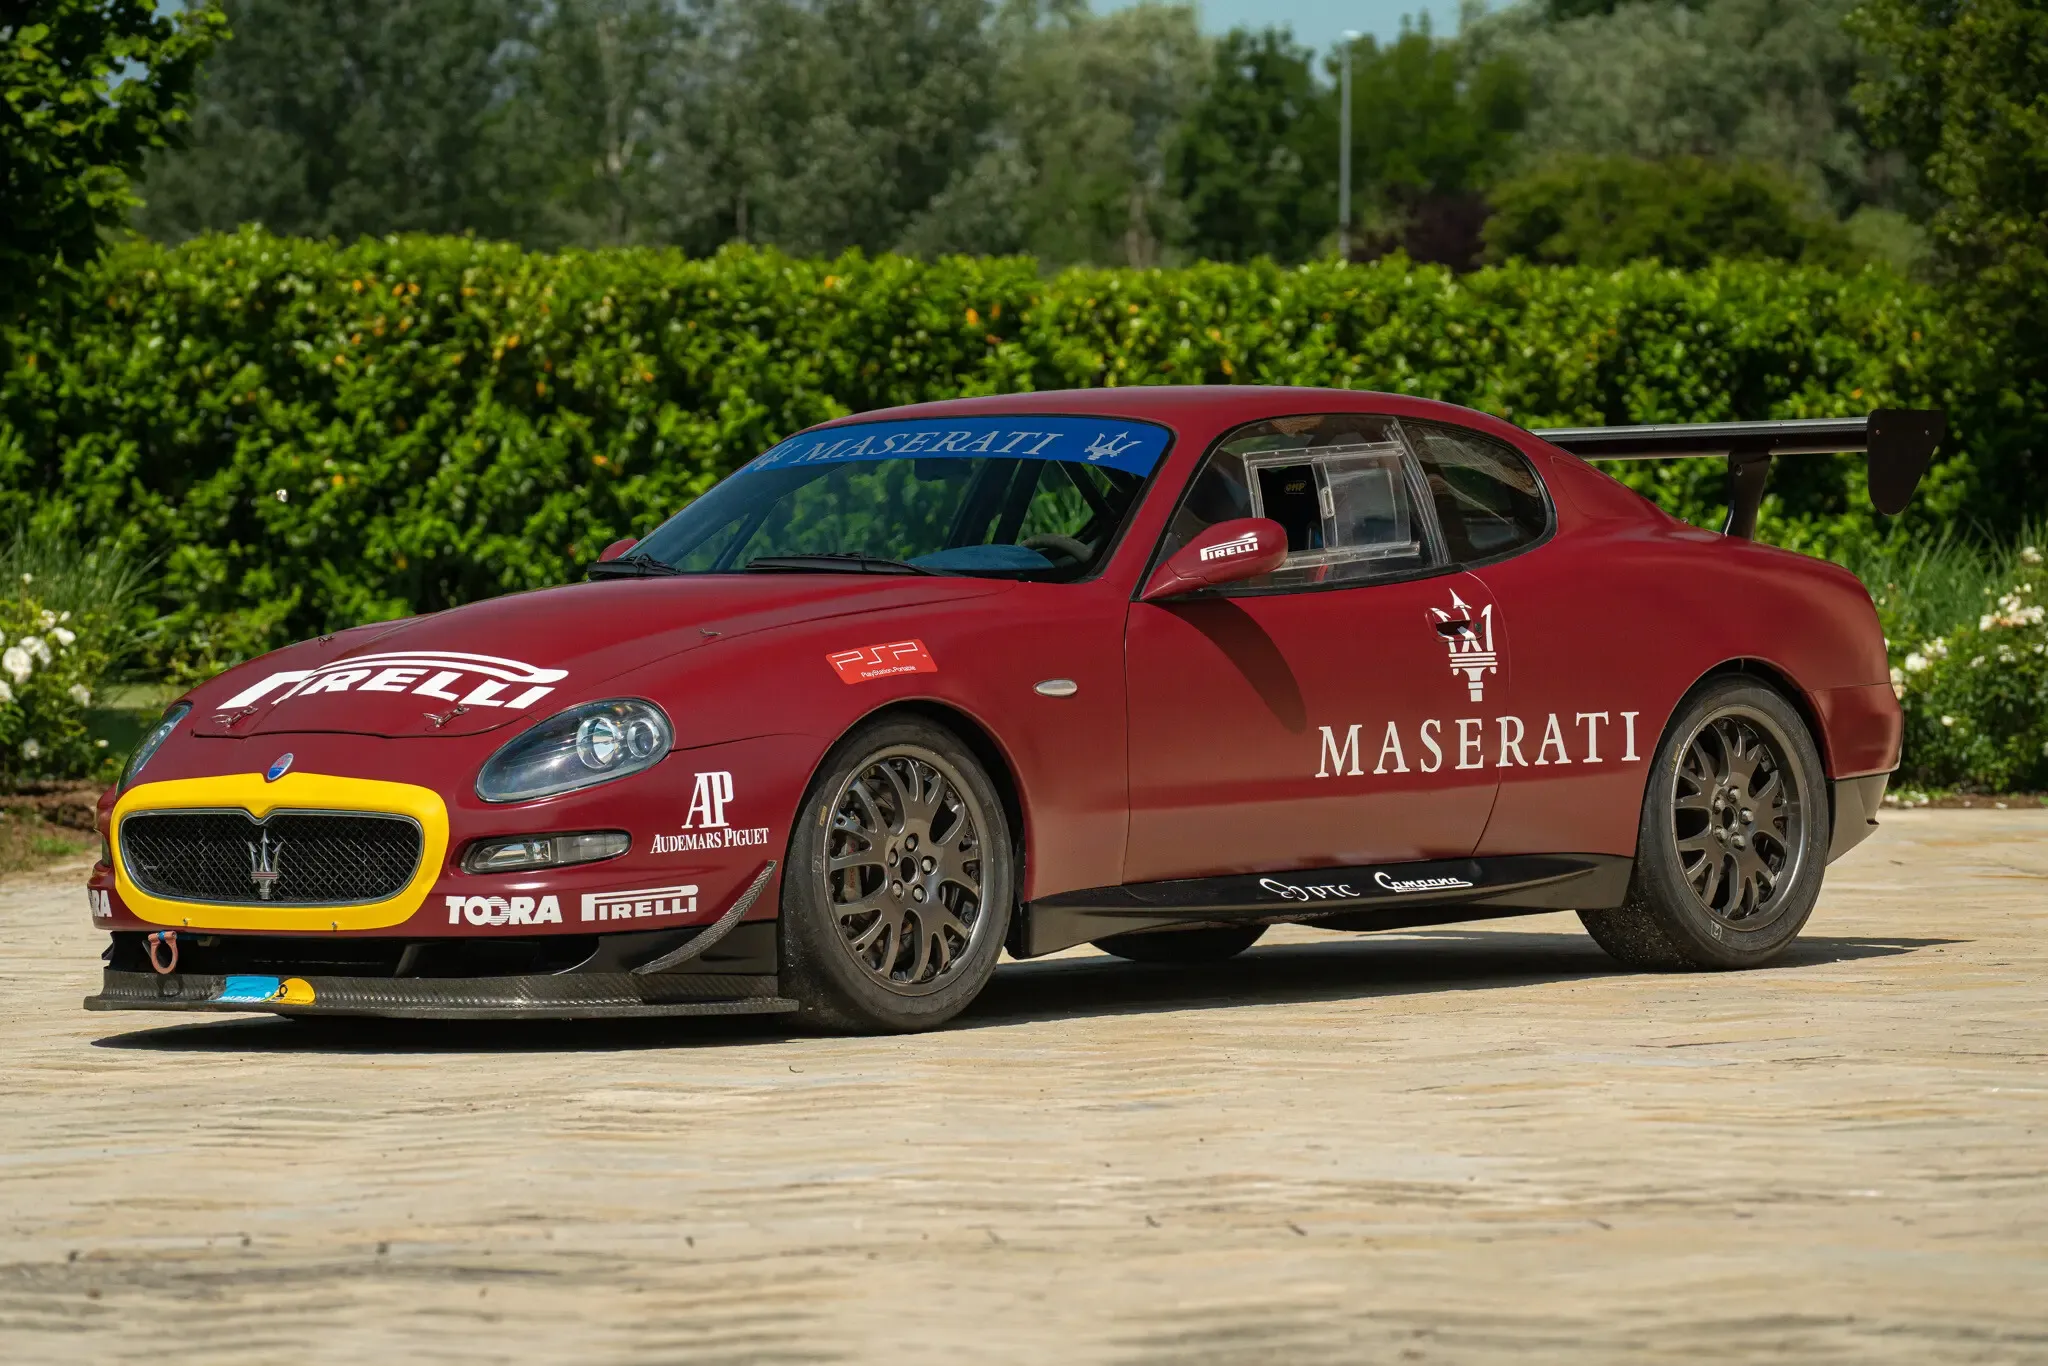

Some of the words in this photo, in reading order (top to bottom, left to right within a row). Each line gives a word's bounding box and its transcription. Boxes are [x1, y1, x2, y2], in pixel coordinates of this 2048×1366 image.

[789, 430, 1063, 465] MASERATI
[1200, 537, 1258, 561] PIRELLI
[832, 642, 918, 670] PSP
[216, 650, 569, 709] PIRELLI
[1315, 711, 1641, 778] MASERATI
[681, 771, 734, 829] AP
[650, 831, 721, 854] AUDEMARS
[723, 828, 770, 848] PIGUET
[445, 895, 562, 926] TOORA
[581, 884, 698, 921] PIRELLI
